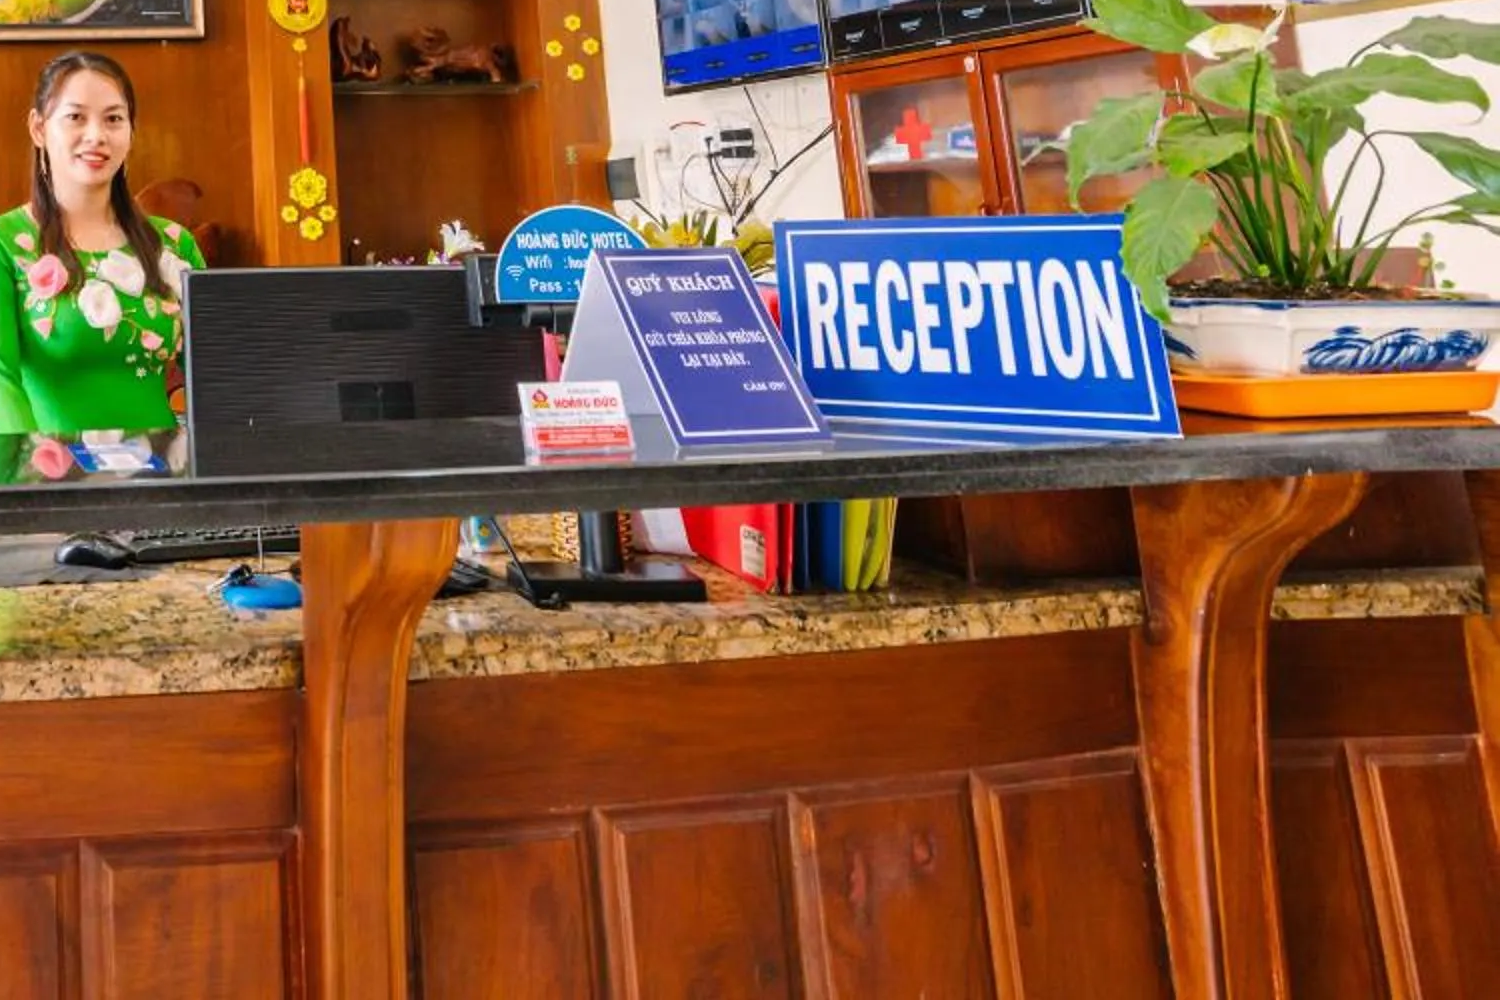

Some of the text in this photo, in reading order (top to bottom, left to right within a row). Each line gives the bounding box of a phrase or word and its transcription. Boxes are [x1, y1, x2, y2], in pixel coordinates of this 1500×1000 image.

[516, 229, 560, 249] HOÀNG
[591, 231, 633, 249] HOTEL
[528, 277, 563, 293] Pass
[625, 272, 736, 296] QUÝ KHÁCH
[803, 259, 1135, 381] RECEPTION
